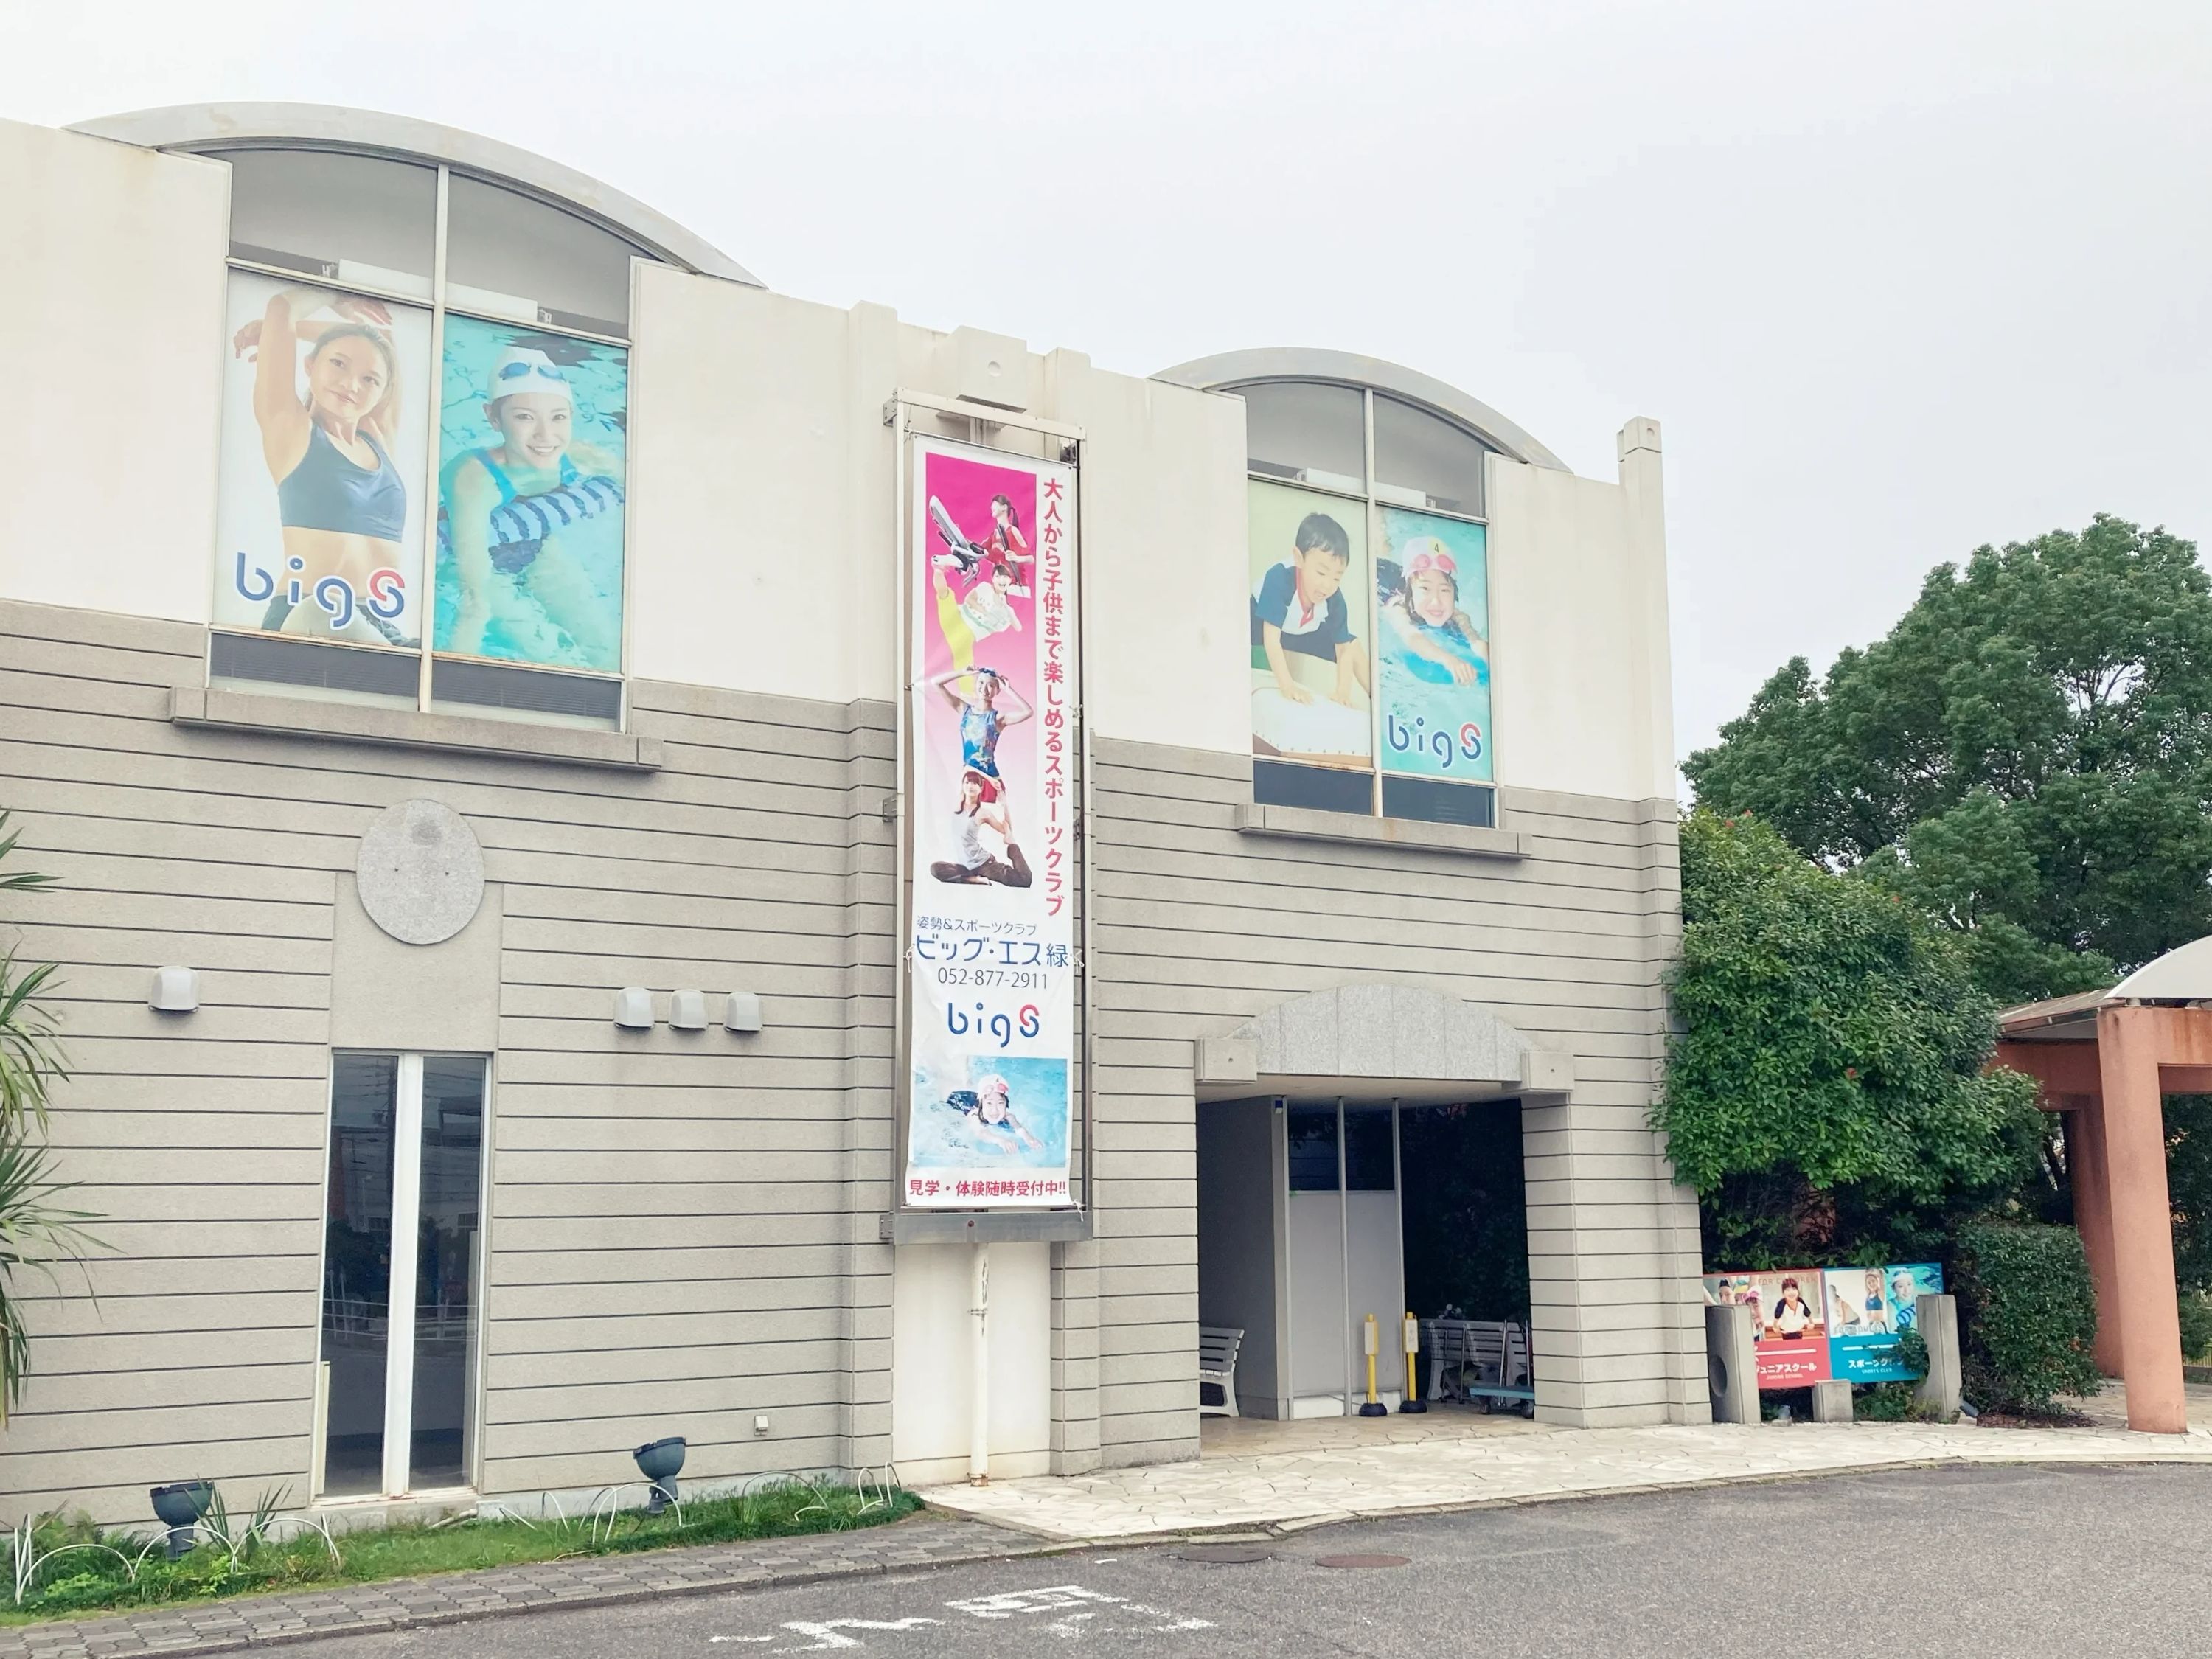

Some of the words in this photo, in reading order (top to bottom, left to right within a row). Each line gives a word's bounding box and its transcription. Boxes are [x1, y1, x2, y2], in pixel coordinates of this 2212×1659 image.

[1434, 543, 1439, 553] 4
[1043, 478, 1064, 917] 大人から子供まで楽しめるスポーツクラブ
[938, 967, 1048, 990] 052-877-2911
[910, 1180, 1066, 1197] 見学・体験随時受付中!!
